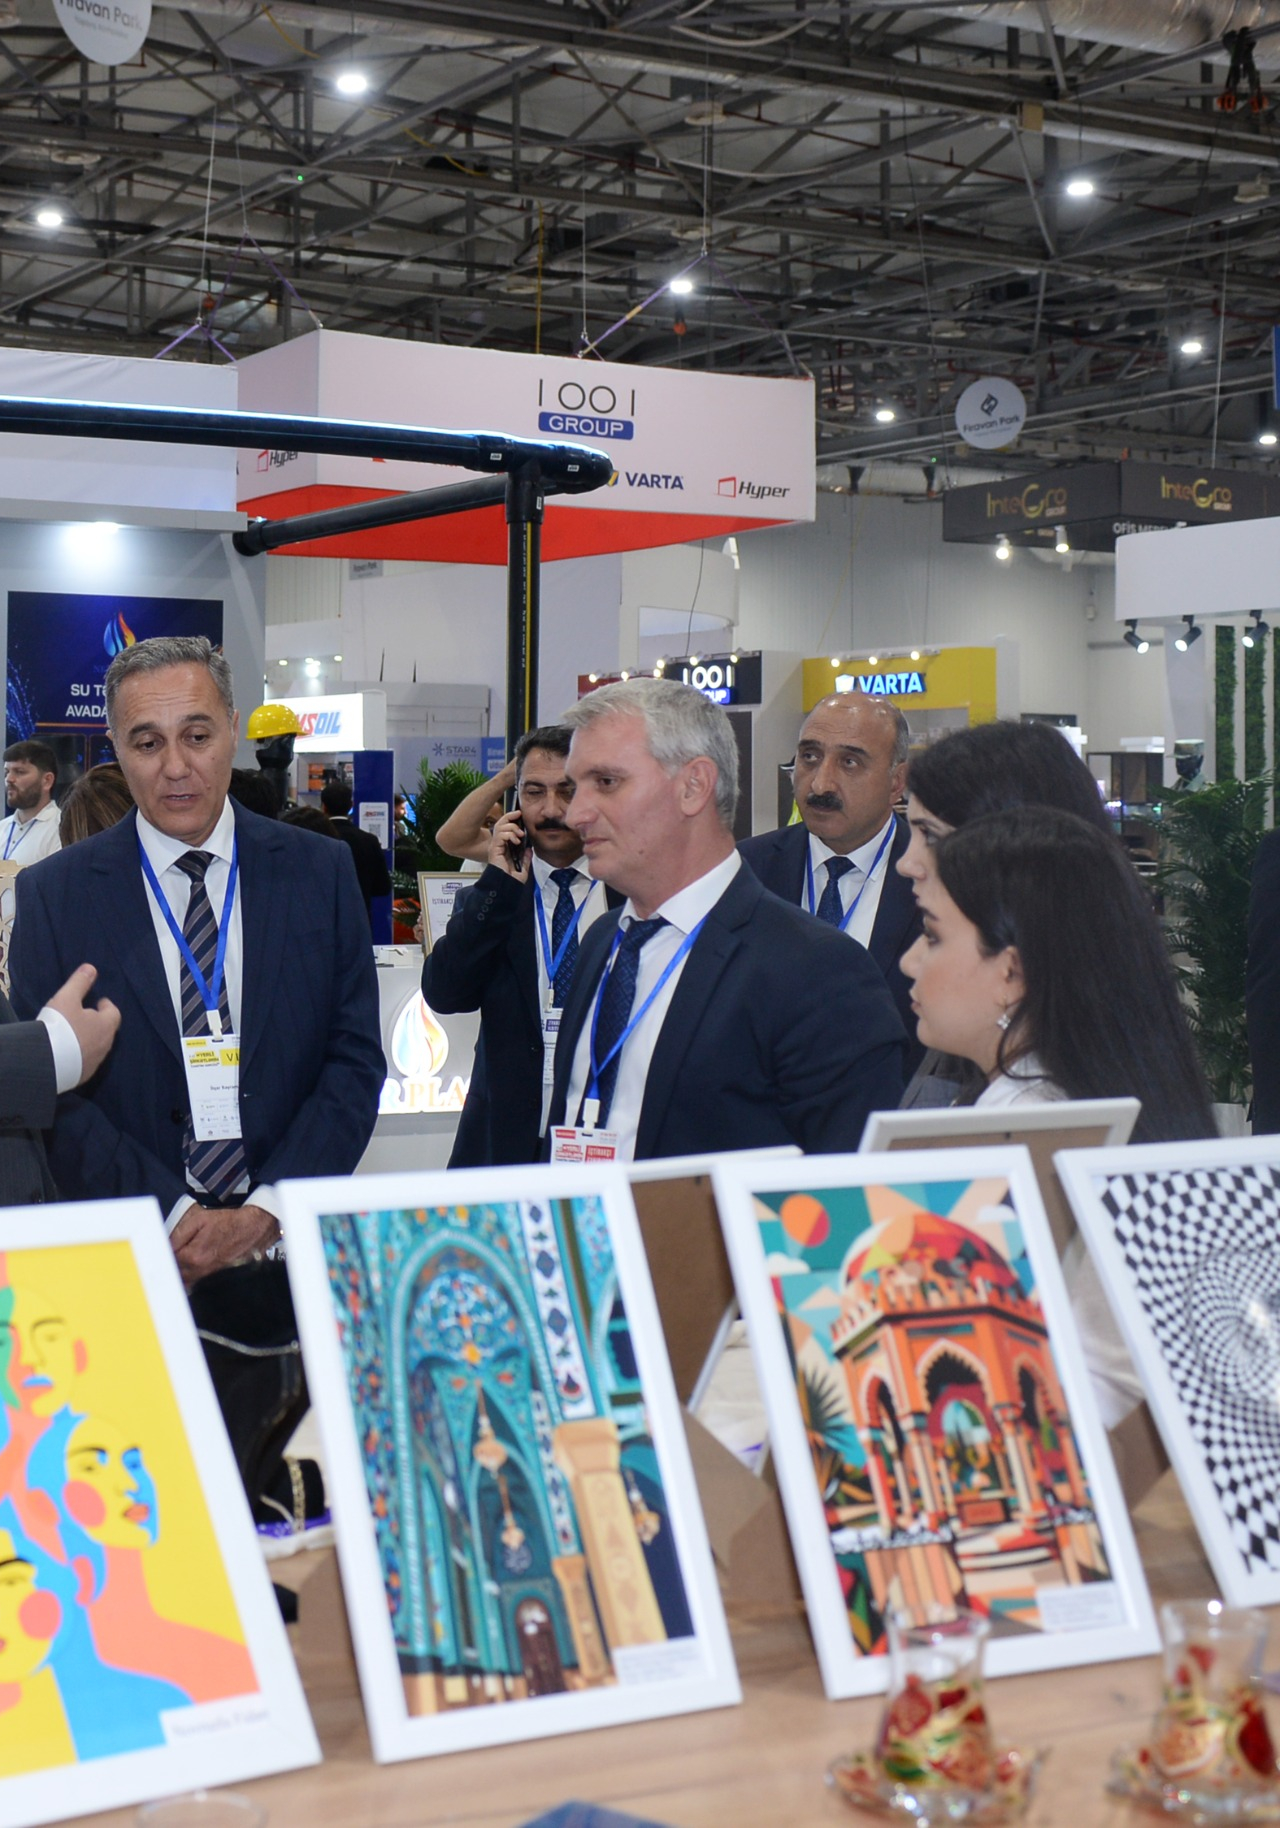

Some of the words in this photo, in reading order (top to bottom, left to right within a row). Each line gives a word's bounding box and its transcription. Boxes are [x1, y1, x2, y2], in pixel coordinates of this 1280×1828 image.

[548, 415, 625, 437] GROUP
[625, 471, 684, 491] VARTA
[738, 481, 790, 500] Hyper
[70, 683, 91, 697] SU
[858, 671, 925, 695] VARTA
